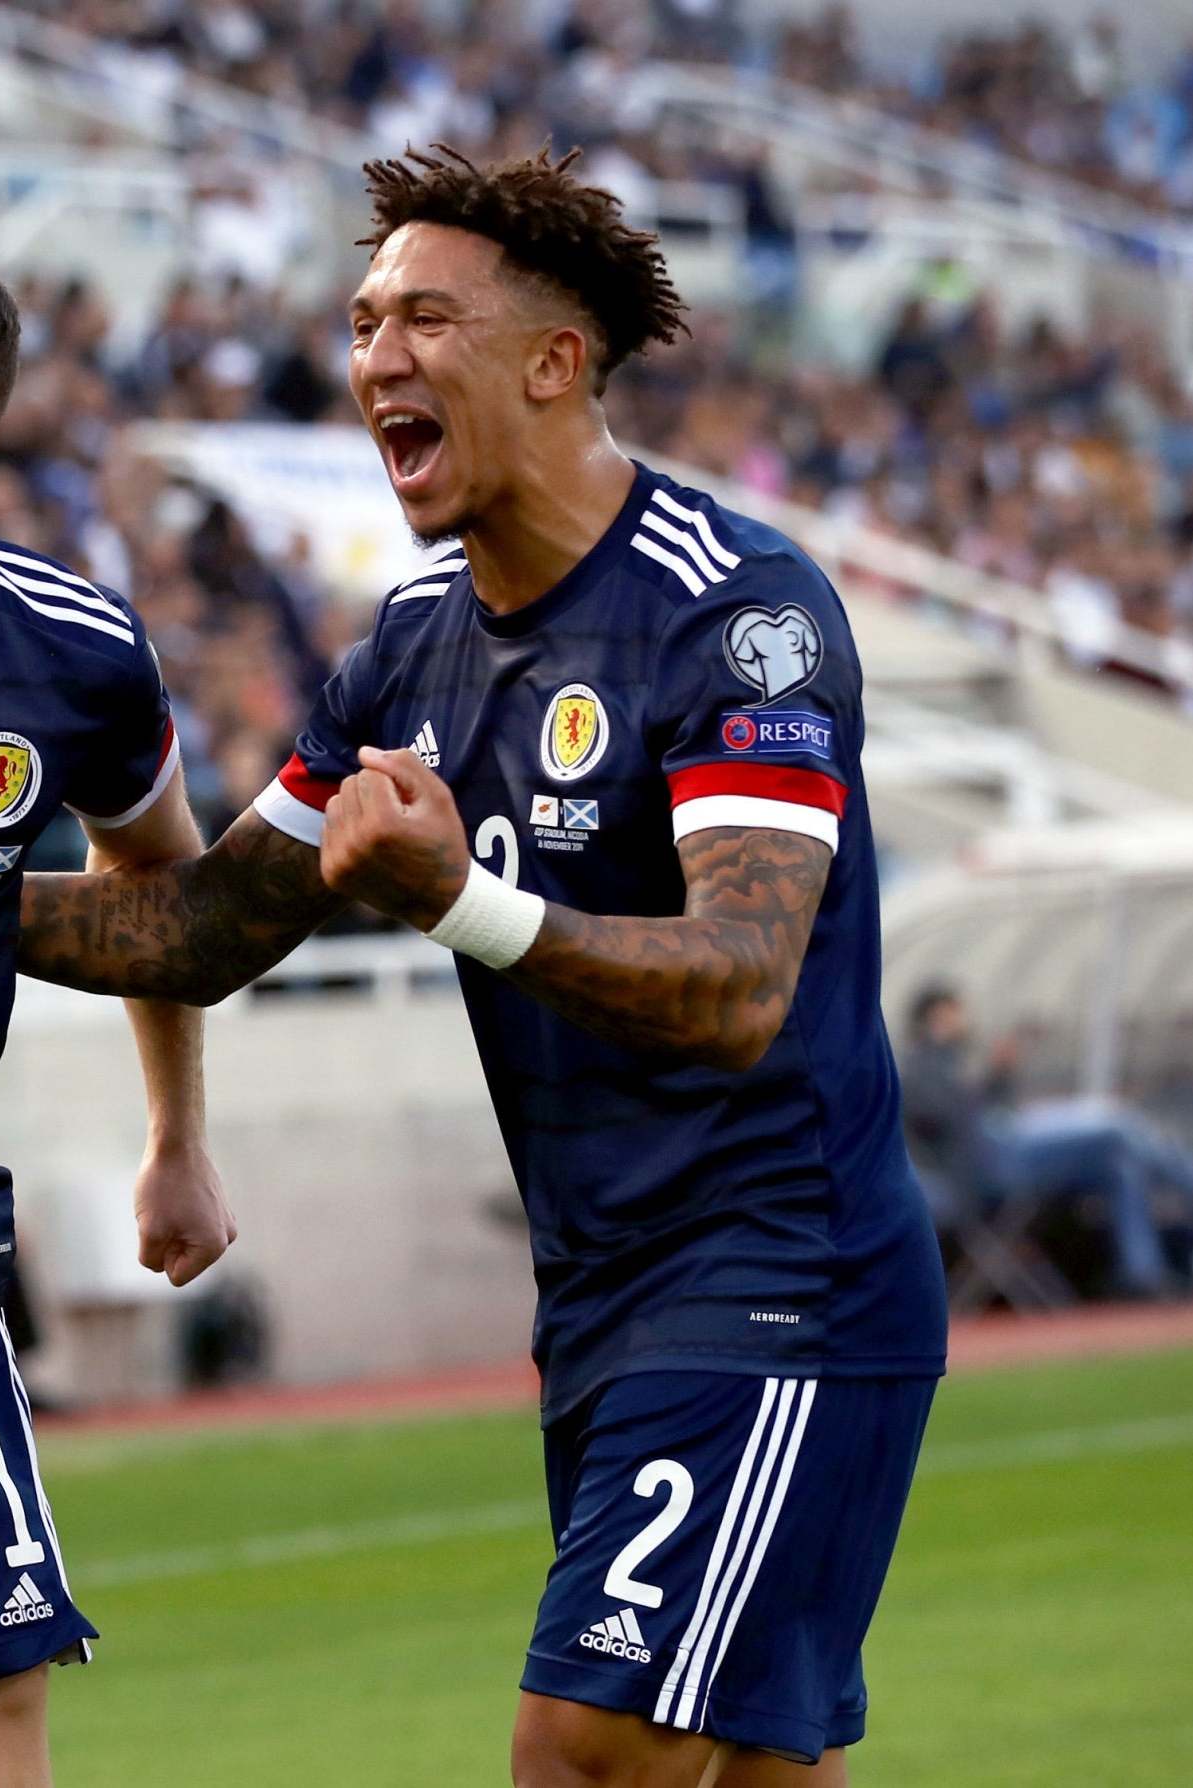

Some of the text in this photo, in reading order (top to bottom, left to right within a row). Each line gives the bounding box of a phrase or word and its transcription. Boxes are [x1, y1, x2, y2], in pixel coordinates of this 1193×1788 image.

[759, 722, 831, 748] RESPECT
[475, 815, 519, 889] 2
[749, 1311, 800, 1324] AEROREADY
[603, 1458, 694, 1609] 2
[0, 1602, 54, 1627] adidas
[579, 1631, 652, 1664] adidas
